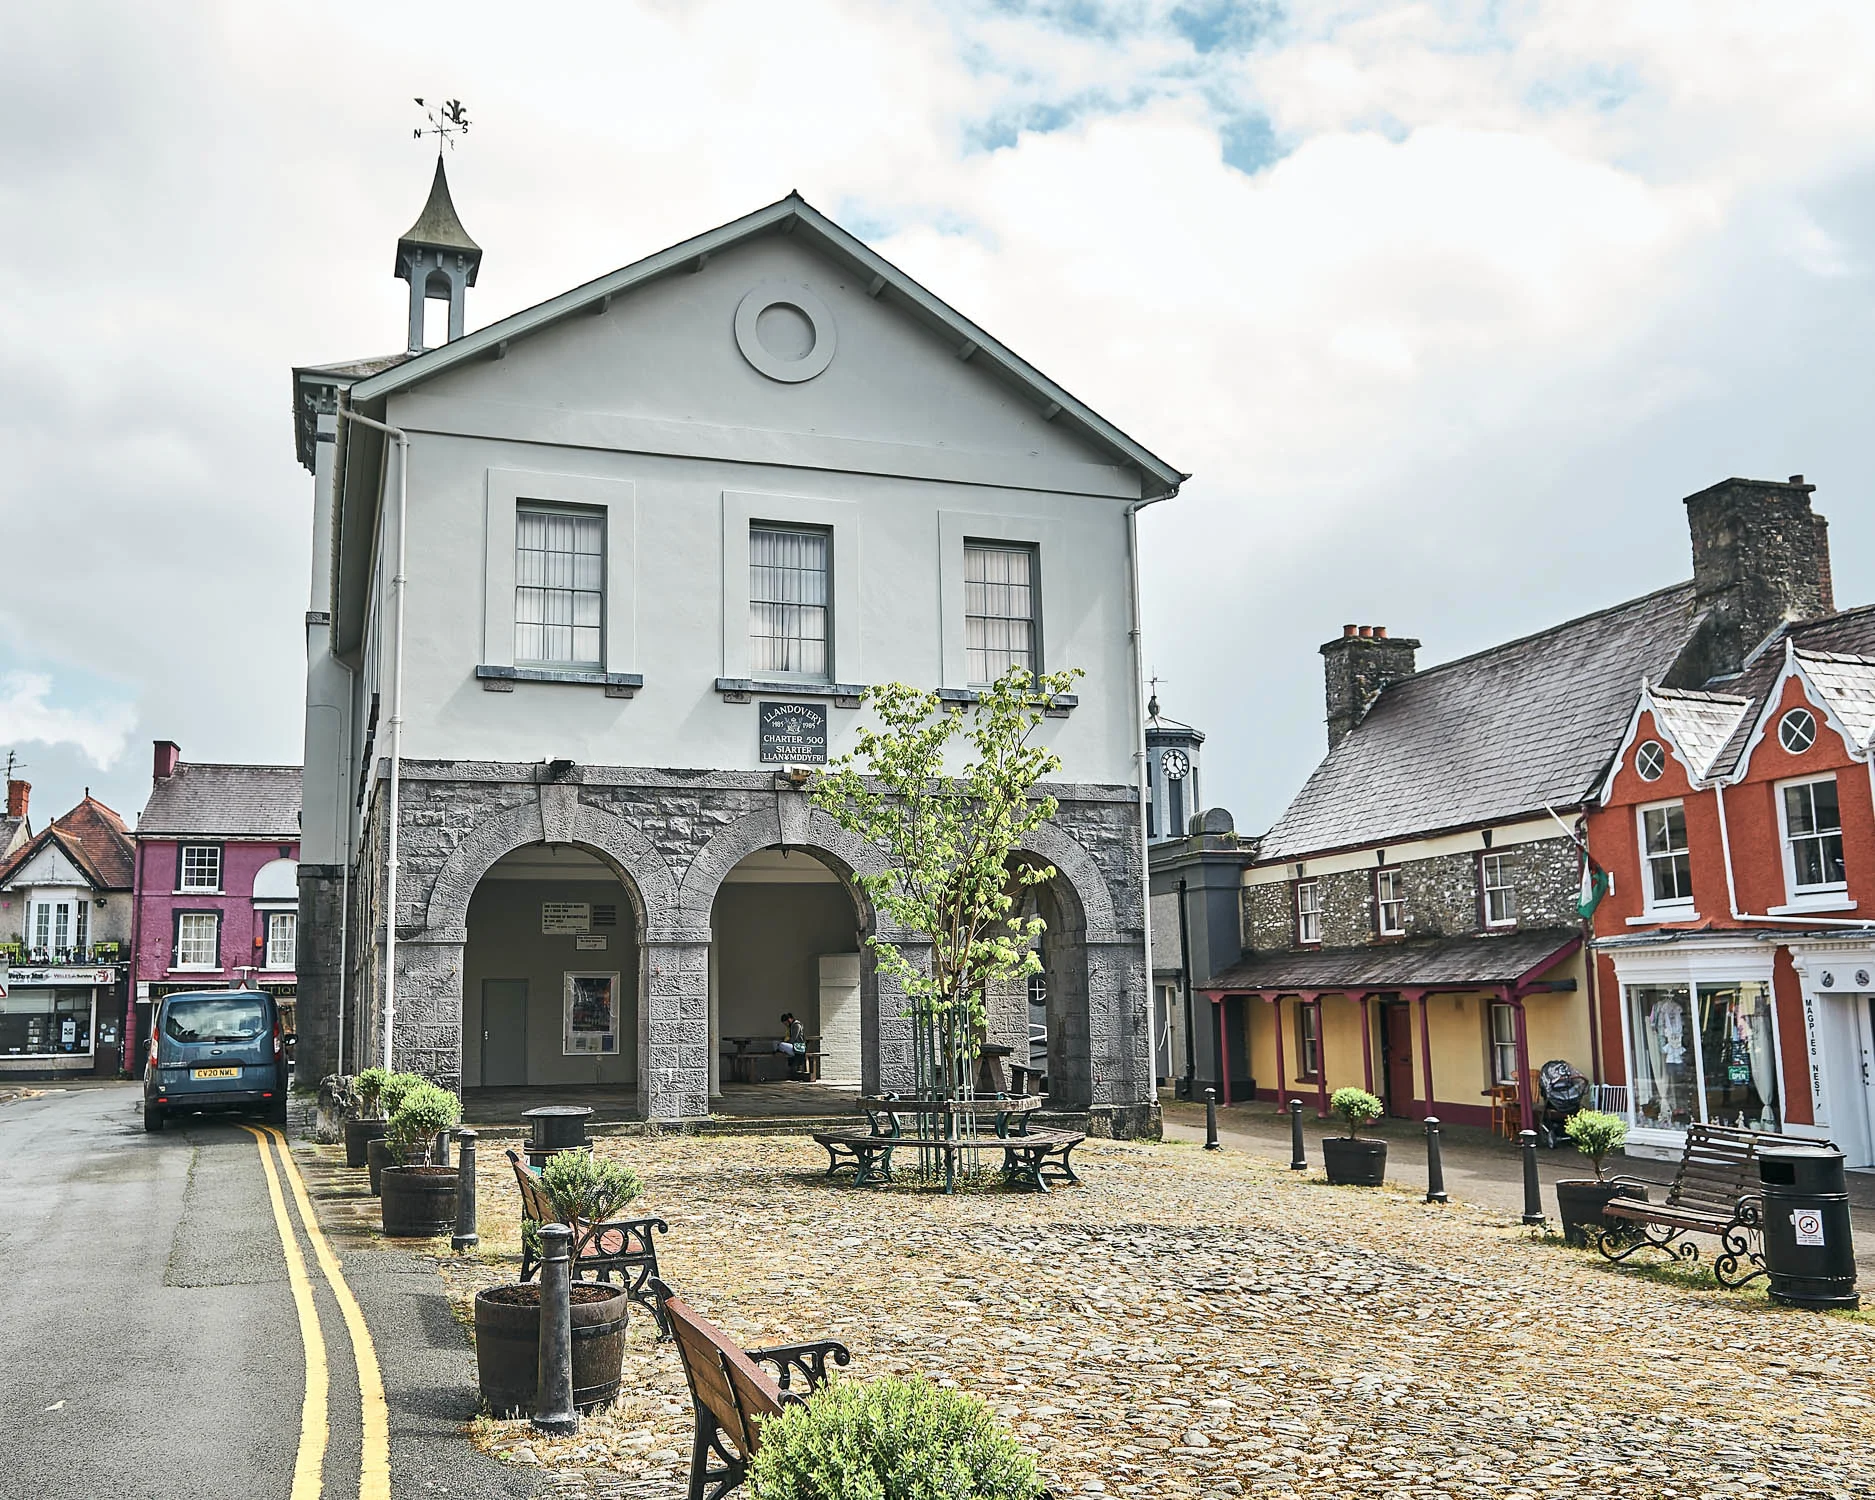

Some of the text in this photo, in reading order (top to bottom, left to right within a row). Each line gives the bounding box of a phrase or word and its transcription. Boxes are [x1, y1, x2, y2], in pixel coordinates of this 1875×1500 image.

[413, 128, 422, 139] N
[763, 704, 824, 726] LLANDOVERY
[763, 734, 824, 745] CHARTER 500
[775, 745, 812, 754] SIARTER
[763, 753, 824, 762] LLANYMDDYFRI
[1805, 999, 1818, 1056] MAGPIES
[197, 1069, 218, 1077] CV20
[1812, 1064, 1821, 1097] NEST
